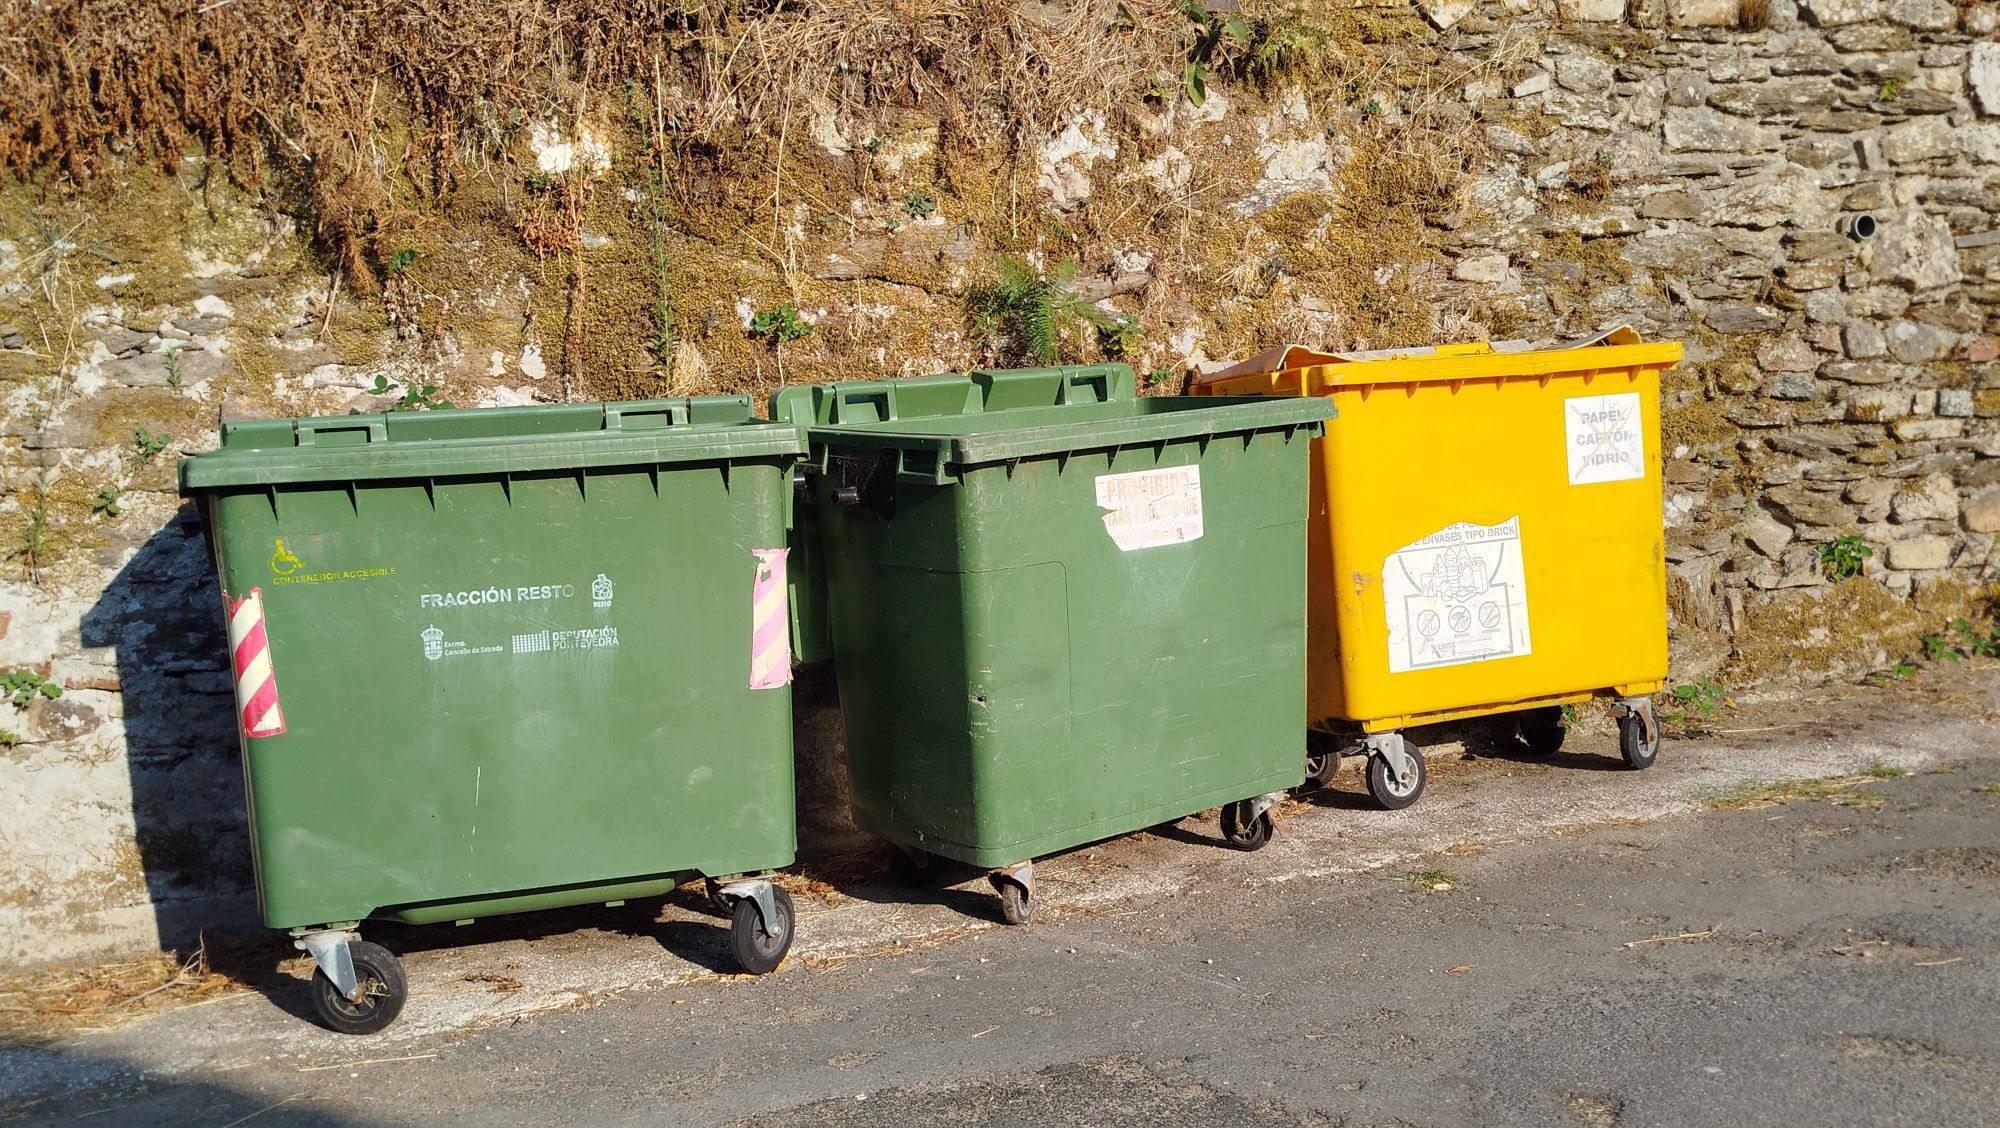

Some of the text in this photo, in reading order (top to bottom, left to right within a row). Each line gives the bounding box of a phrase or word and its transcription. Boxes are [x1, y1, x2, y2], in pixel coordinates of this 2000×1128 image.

[1581, 410, 1626, 424] PAPEL
[1576, 427, 1633, 446] CARTÓN
[1582, 451, 1629, 466] VIDRIO
[1107, 472, 1190, 502] PROHIBIDO
[1103, 503, 1132, 526] IXAR
[1422, 531, 1463, 545] ENVASES
[1464, 529, 1485, 540] TIPO
[1487, 525, 1515, 538] BRICK
[272, 566, 398, 586] CONTENEDOR ACCESIBLE
[420, 584, 576, 608] FRACCIÓN RESTO
[593, 600, 612, 608] RESTO
[552, 626, 618, 641] DEPUTACIÓN
